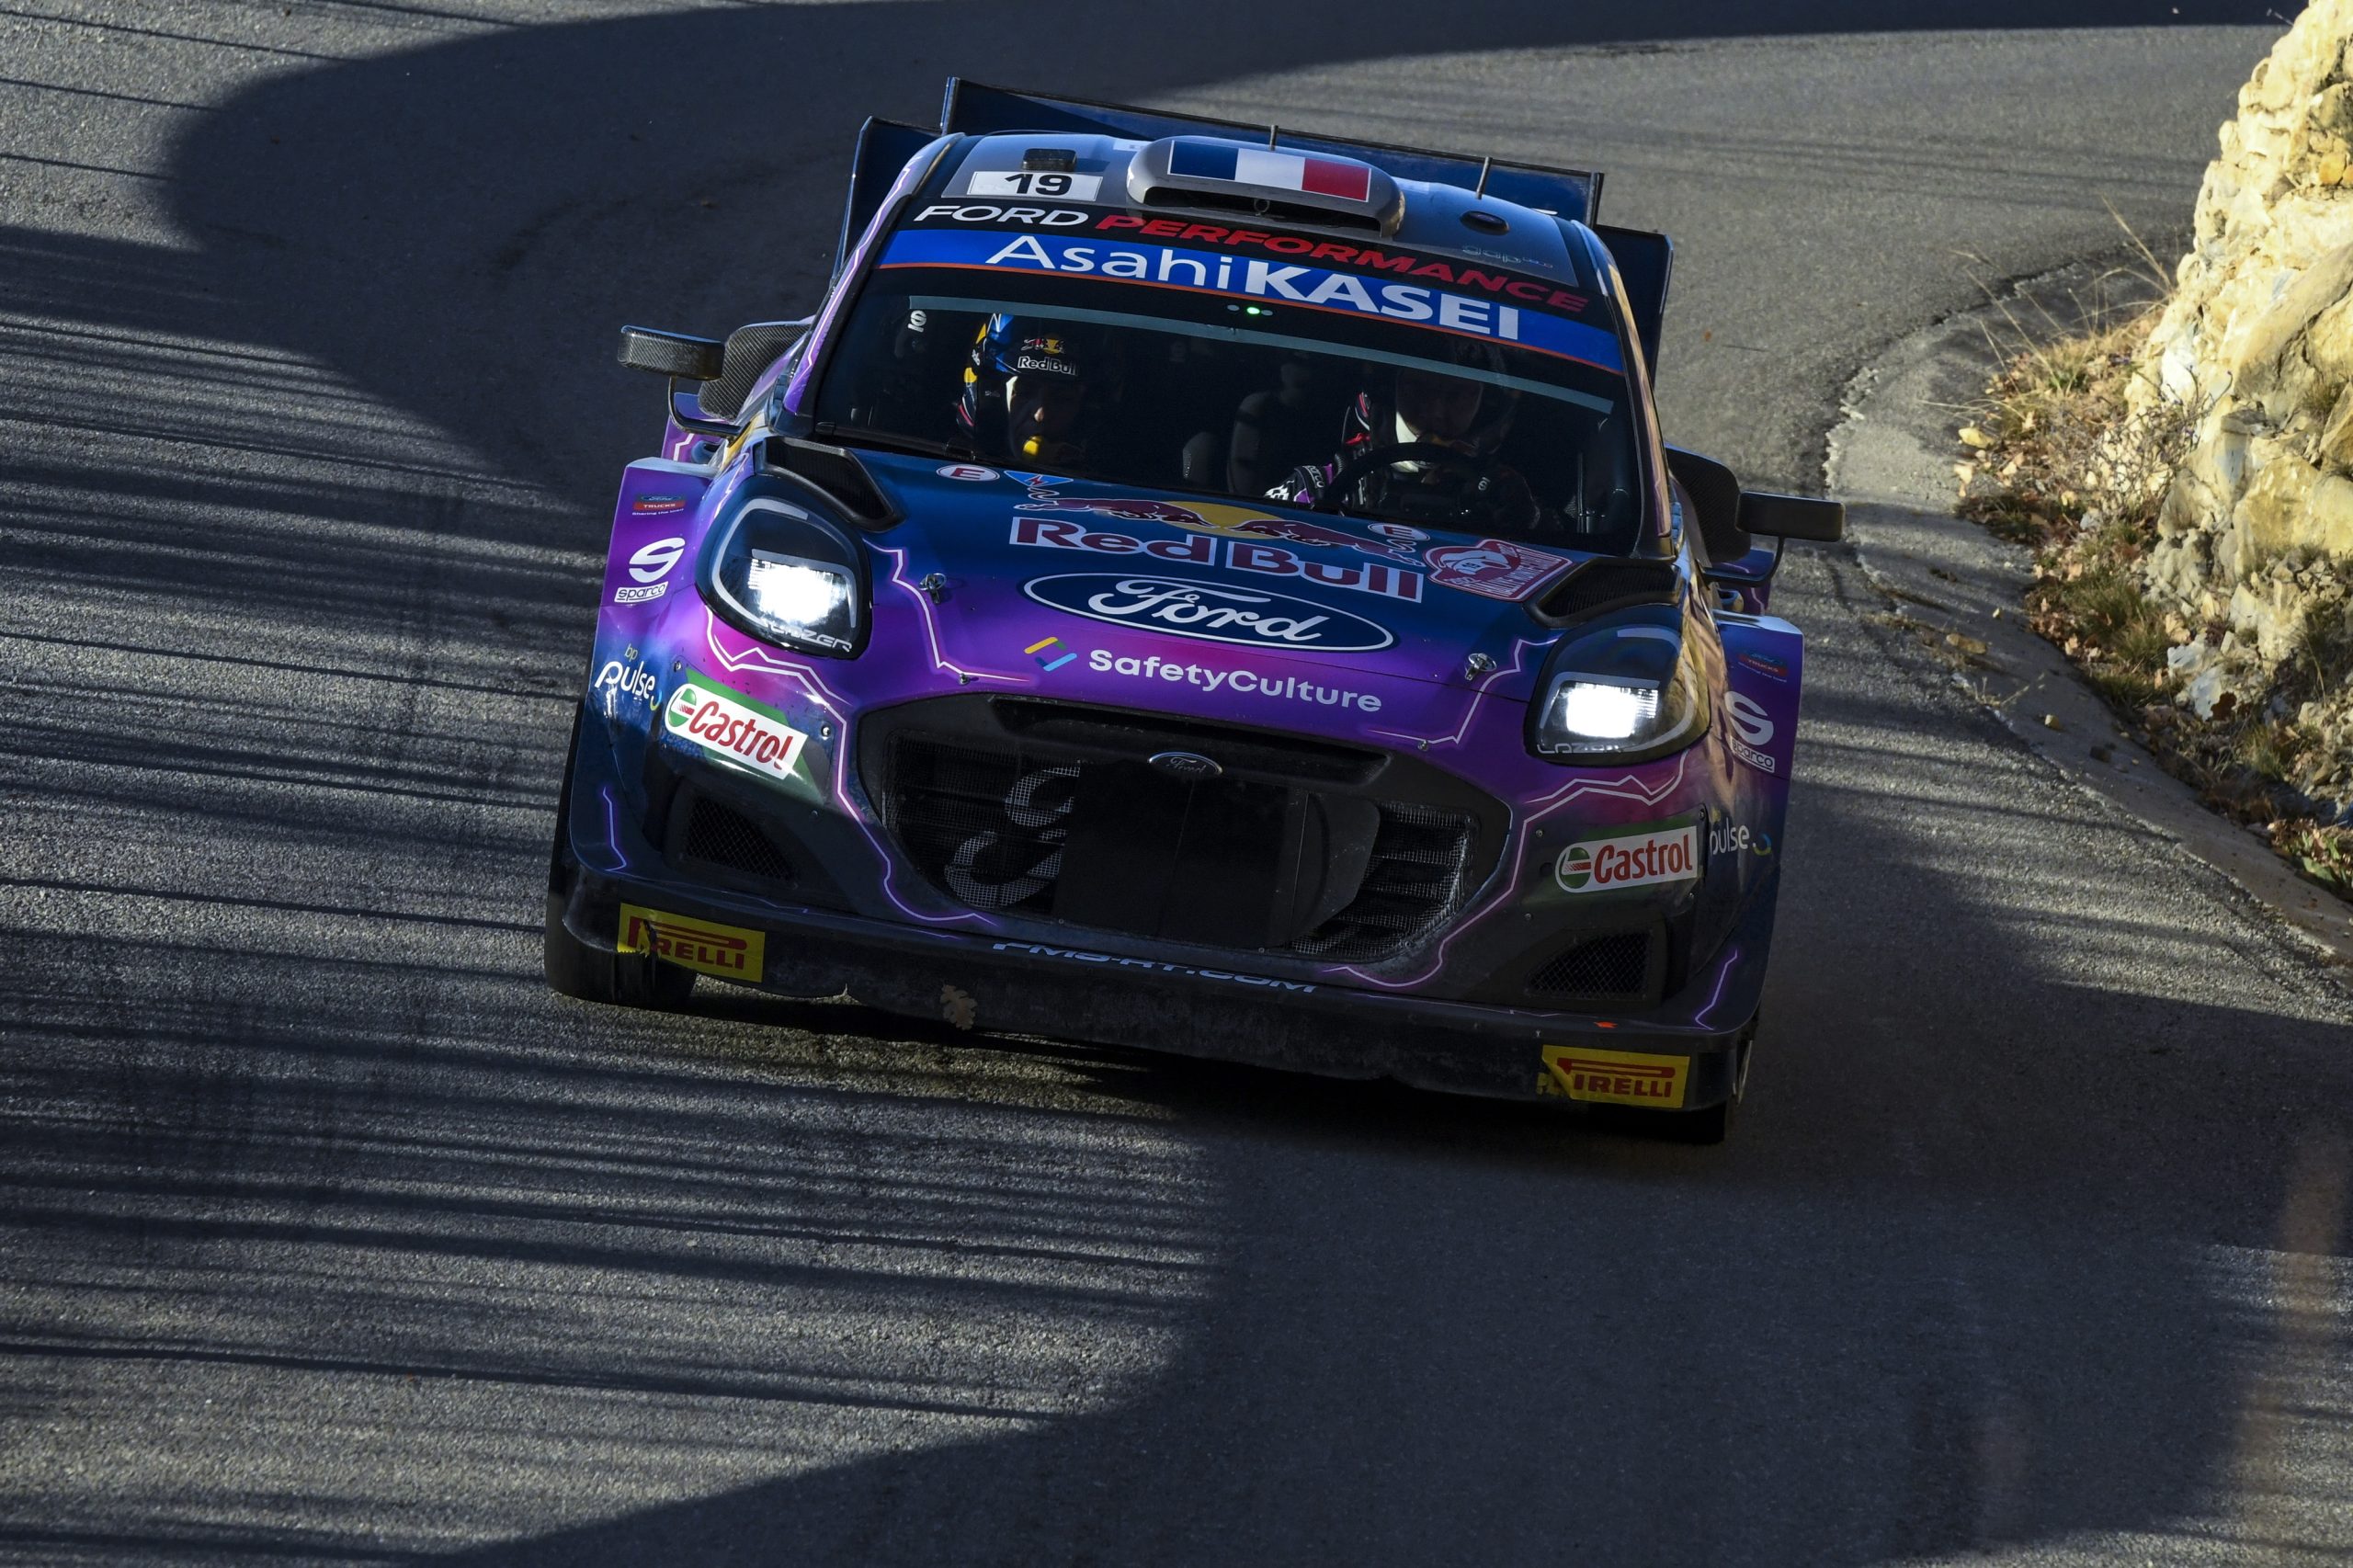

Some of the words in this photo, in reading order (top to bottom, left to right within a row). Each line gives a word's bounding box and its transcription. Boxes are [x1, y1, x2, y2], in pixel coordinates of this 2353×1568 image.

[1005, 173, 1074, 196] 19
[915, 205, 1088, 226] FORD
[1096, 214, 1589, 312] PERFORMANCE
[985, 235, 1518, 340] AsahiKASEI
[1017, 355, 1049, 371] Red
[950, 467, 985, 480] E
[1009, 517, 1218, 566] Red
[1224, 540, 1424, 604] Bull
[618, 583, 667, 602] sparco
[1088, 580, 1330, 642] Ford
[624, 643, 639, 663] bp
[594, 660, 656, 699] pulse
[1089, 649, 1382, 712] SafetyCulture
[688, 700, 794, 770] Castrol
[1732, 736, 1774, 768] sparco
[1710, 816, 1750, 856] pulse
[1594, 834, 1693, 885] Castrol
